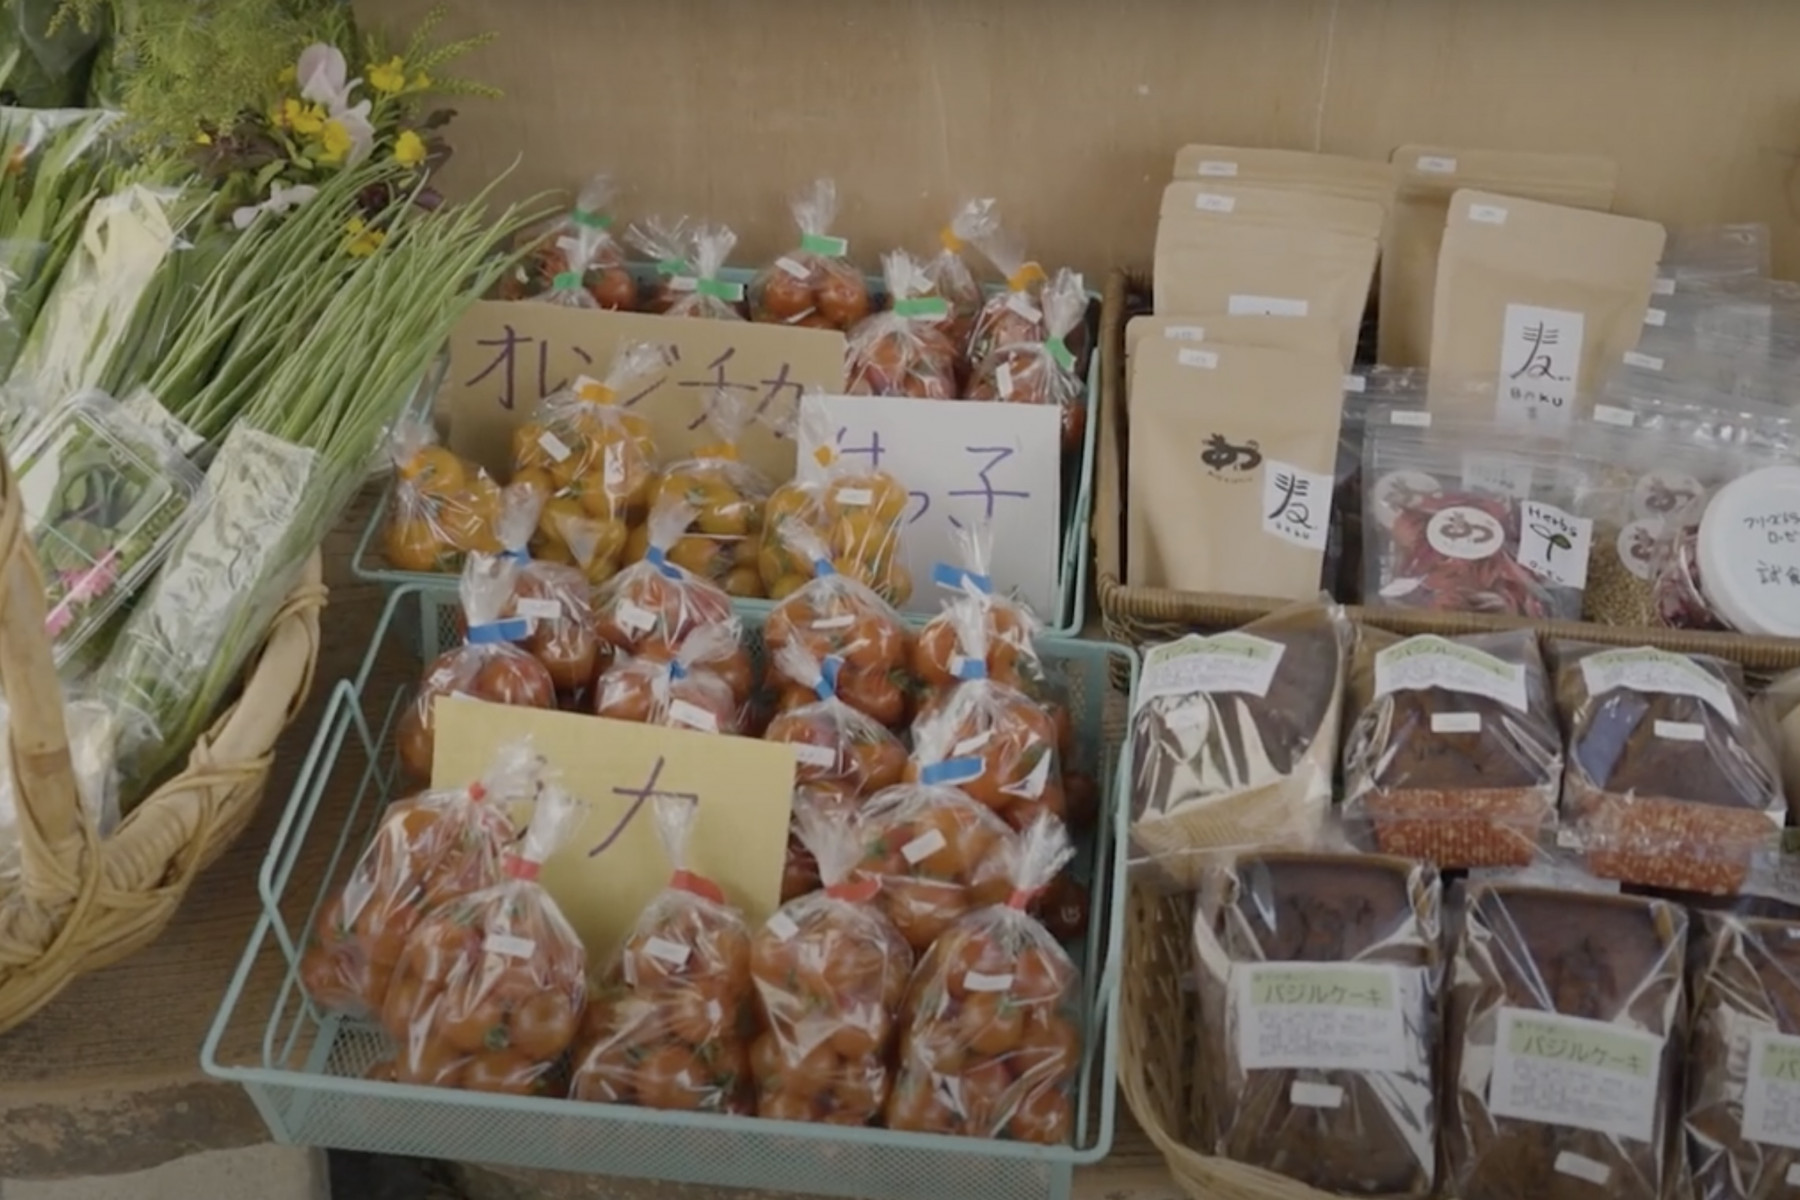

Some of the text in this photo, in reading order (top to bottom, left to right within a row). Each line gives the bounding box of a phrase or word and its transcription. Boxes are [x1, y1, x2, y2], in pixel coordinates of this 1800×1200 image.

[1265, 983, 1382, 1008] バジルケーキ
[1523, 1035, 1642, 1074] バジルケーキ
